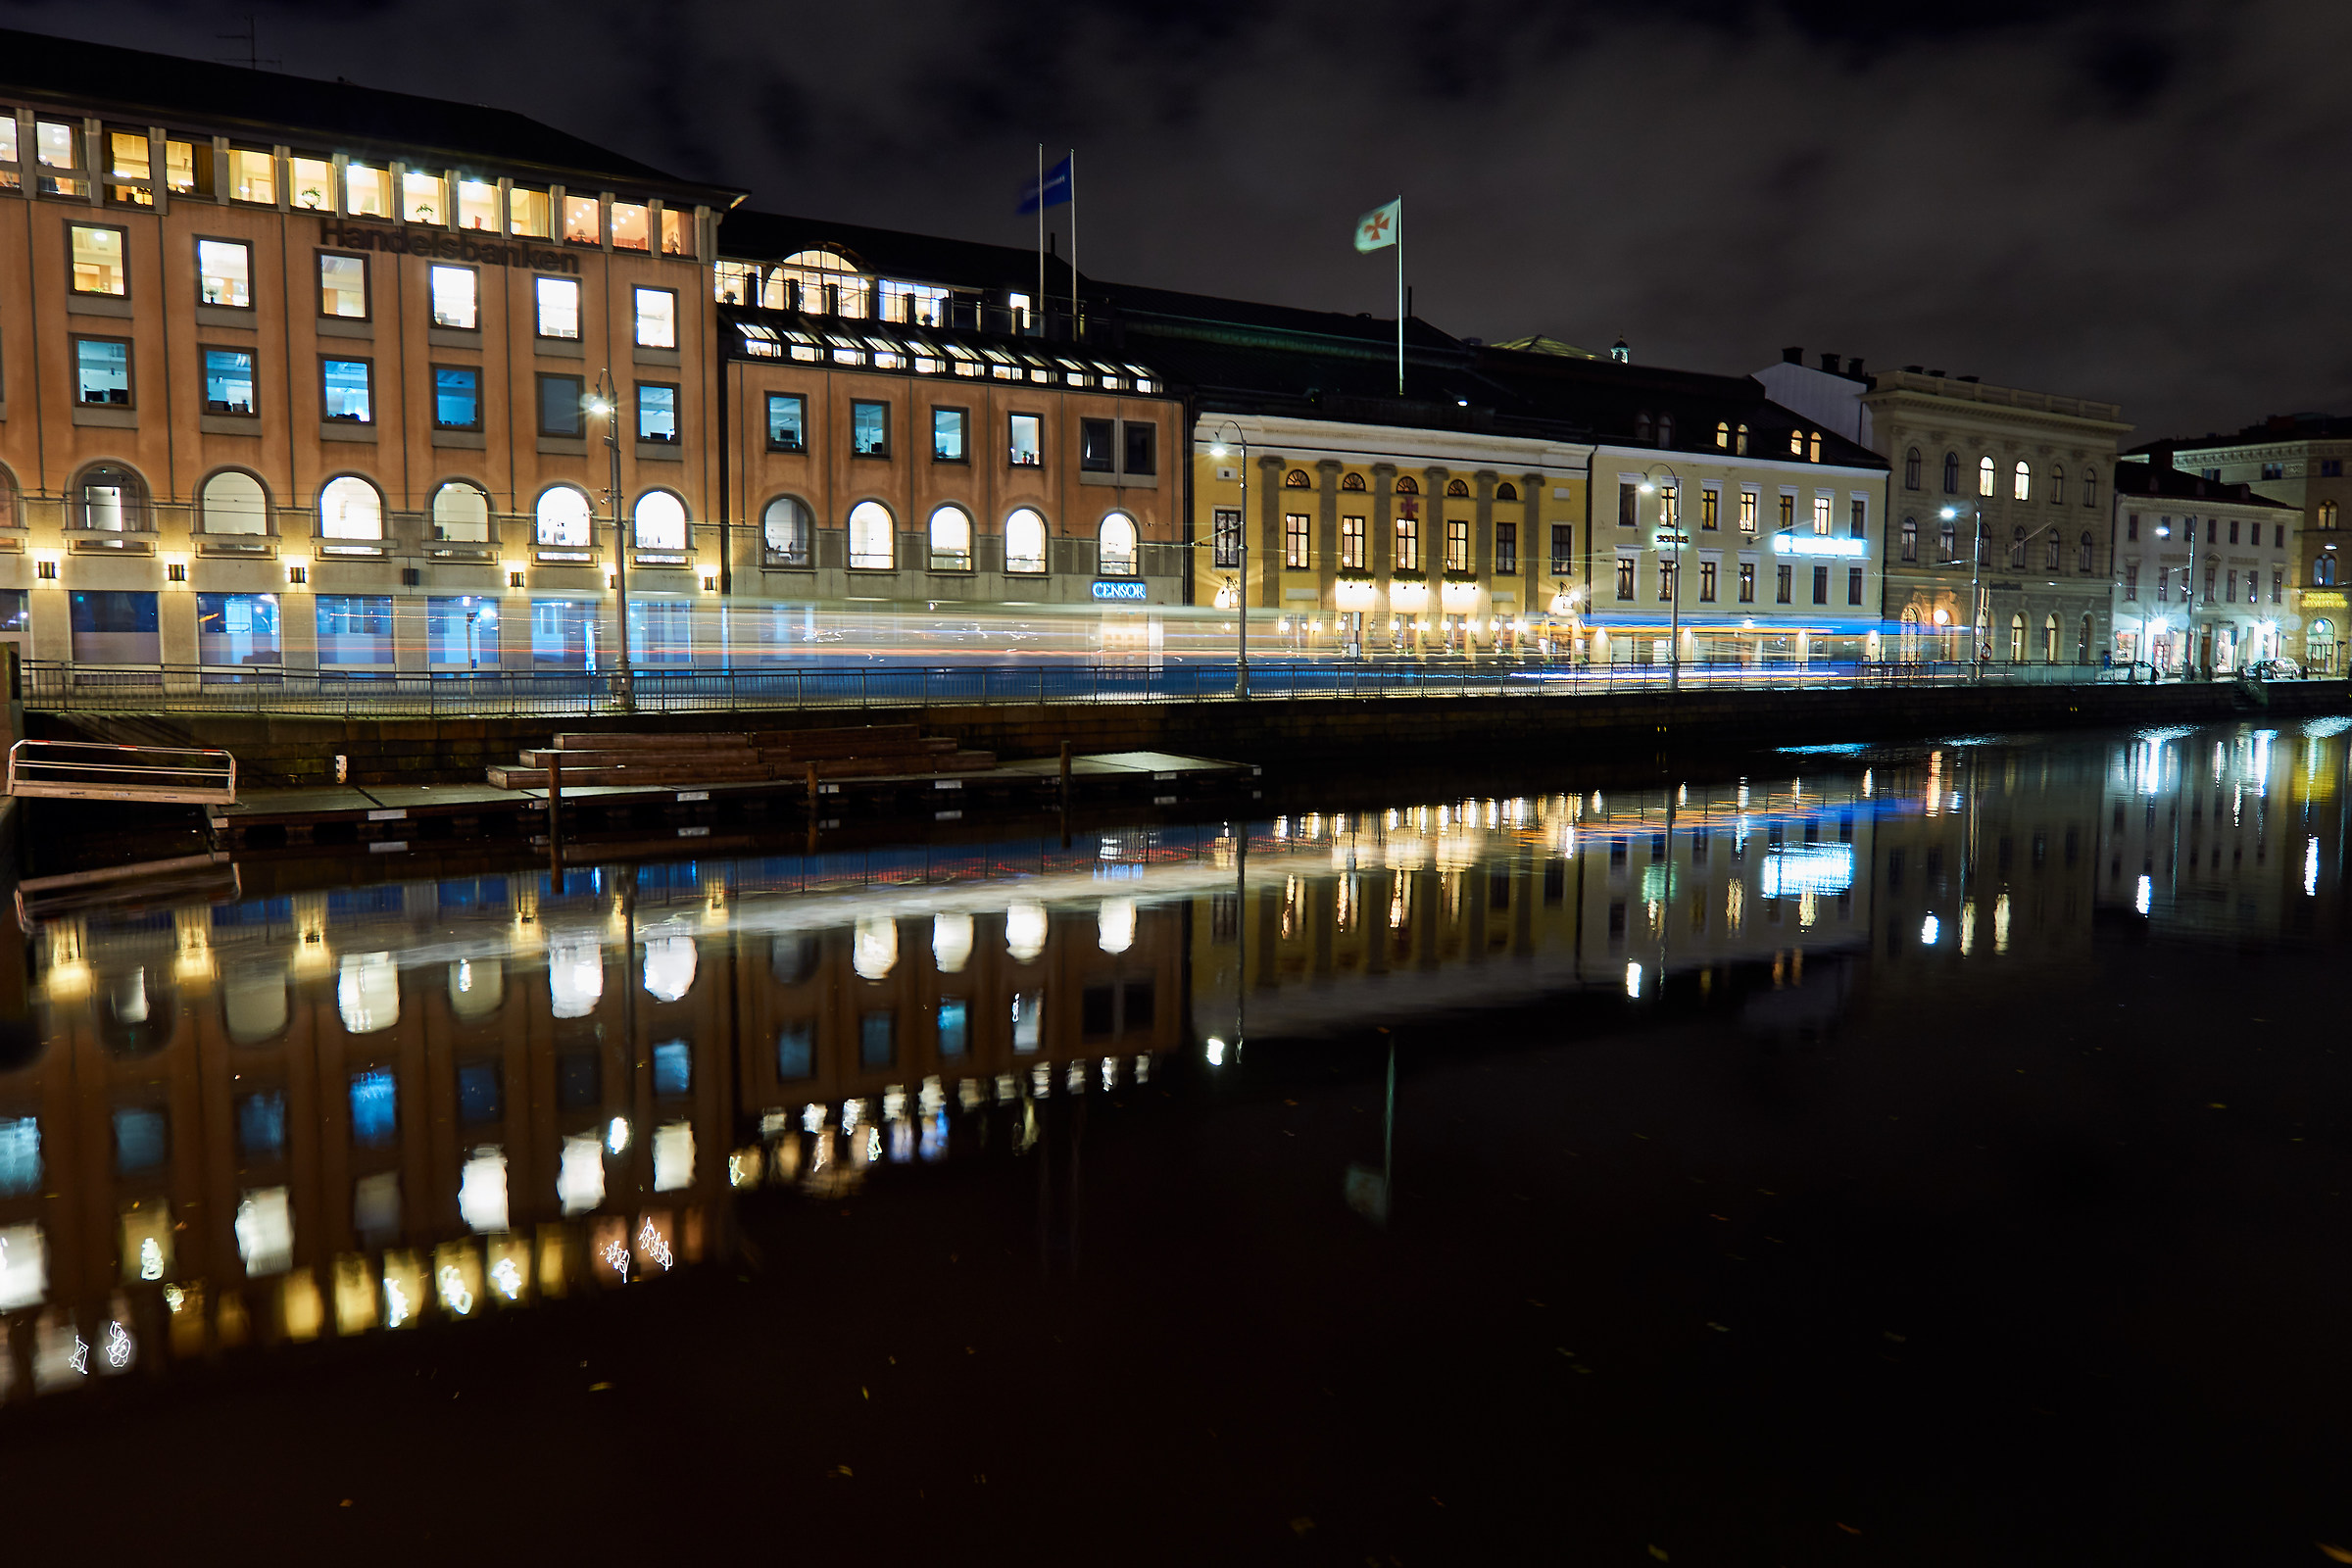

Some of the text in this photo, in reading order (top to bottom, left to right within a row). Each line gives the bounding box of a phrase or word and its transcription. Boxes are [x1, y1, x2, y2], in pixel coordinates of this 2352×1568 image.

[320, 219, 579, 273] Handelsbanken
[1656, 534, 1690, 544] senus
[1092, 581, 1146, 599] CENSOR
